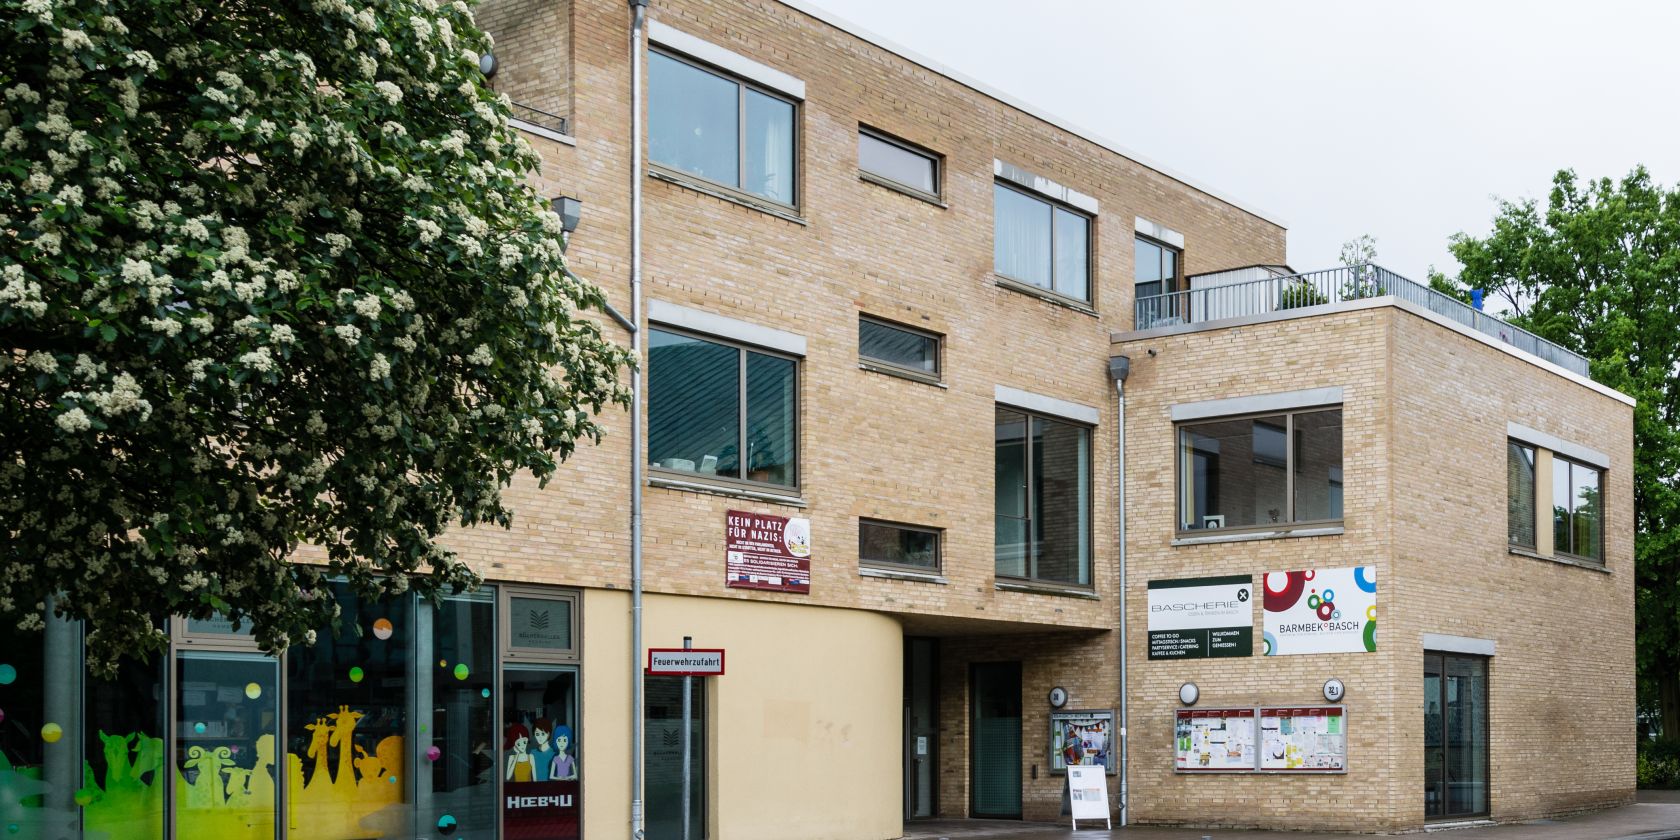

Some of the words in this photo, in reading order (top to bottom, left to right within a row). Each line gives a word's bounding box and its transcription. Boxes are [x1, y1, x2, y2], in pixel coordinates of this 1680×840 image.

[728, 516, 751, 527] KEIN
[755, 519, 782, 531] PLATZ
[728, 527, 746, 538] FÜR
[751, 530, 782, 542] NAZIS:
[1151, 601, 1239, 612] BASCHERIE
[653, 657, 720, 666] Feuerwehrzufahrt
